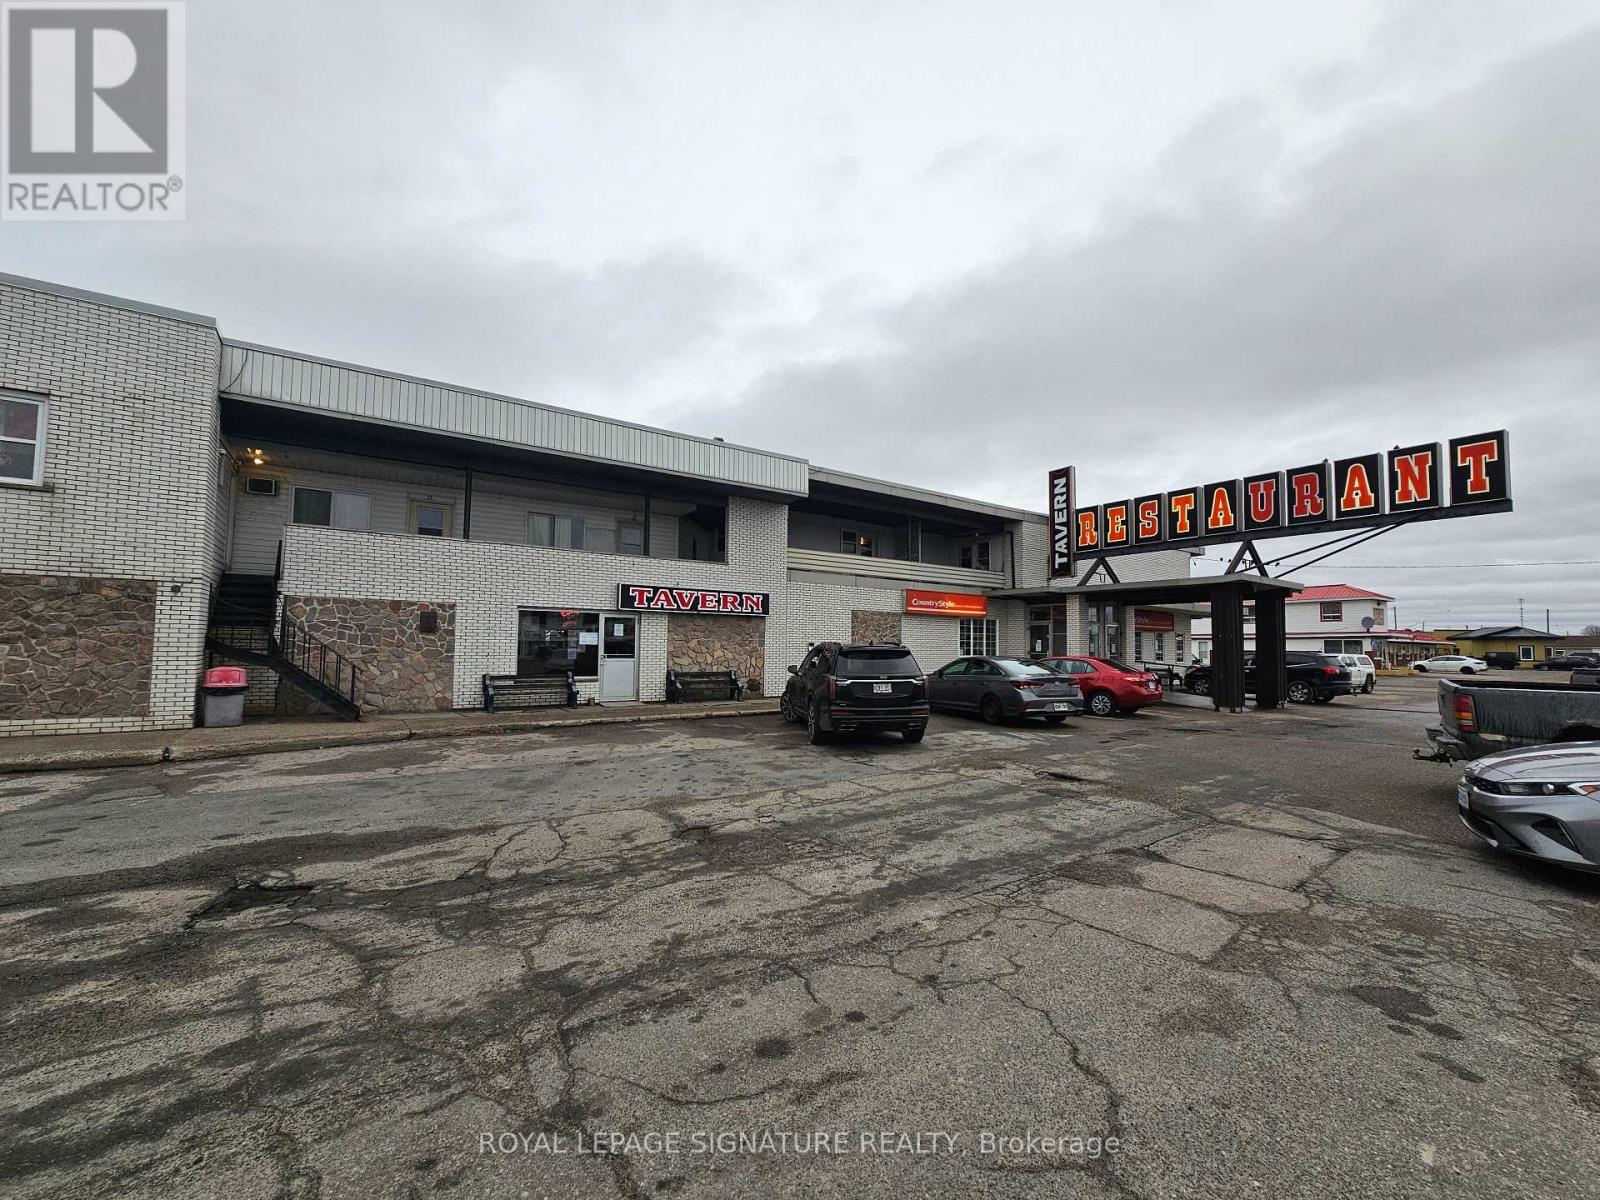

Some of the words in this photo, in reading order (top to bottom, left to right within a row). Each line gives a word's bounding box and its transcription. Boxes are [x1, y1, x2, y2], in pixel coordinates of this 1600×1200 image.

[1053, 477, 1068, 569] TAVERN
[1078, 439, 1498, 547] RESTAURANT
[629, 587, 764, 613] TAVERN
